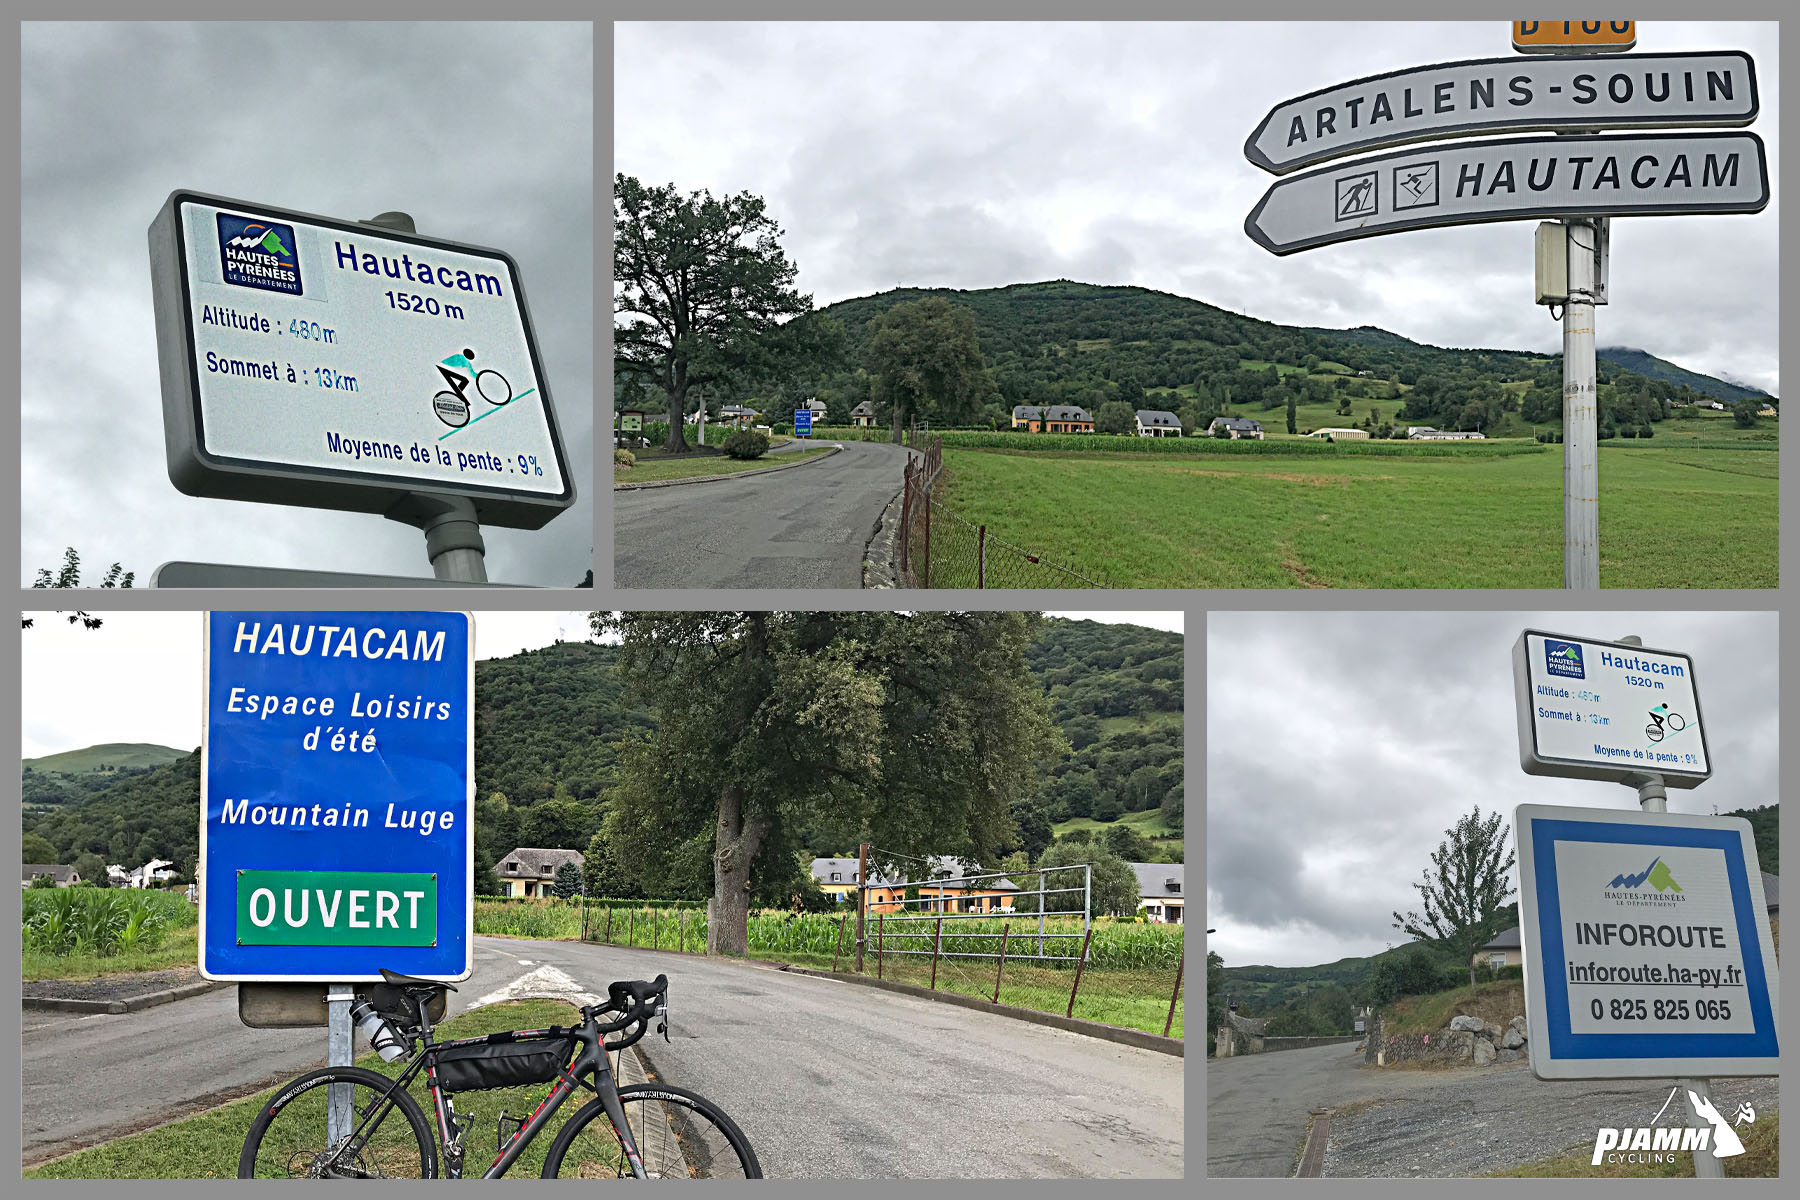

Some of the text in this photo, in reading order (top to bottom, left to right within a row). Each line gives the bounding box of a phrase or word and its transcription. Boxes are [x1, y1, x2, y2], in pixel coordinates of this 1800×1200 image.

[1286, 70, 1734, 147] ARTALENS-SOUIN
[1455, 152, 1740, 198] HAUTACAM
[227, 261, 296, 282] PYRÉNÉES
[229, 273, 297, 290] LE DÉPARTEMENT
[335, 241, 503, 297] Hautacam
[202, 304, 271, 333] Altitude
[385, 290, 465, 320] 1520 m
[206, 351, 280, 381] Sommet
[287, 363, 297, 383] à
[315, 367, 359, 392] 13km
[326, 431, 403, 460] Moyenne
[410, 442, 431, 463] de
[435, 445, 452, 466] la
[457, 451, 503, 472] pente
[517, 454, 543, 477] 9%
[233, 622, 447, 662] HAUTACAM
[1601, 651, 1684, 677] Hautacam
[1537, 684, 1569, 698] Altitude
[1625, 675, 1664, 689] 1520 m
[227, 687, 451, 721] Espace Loisirs
[1538, 707, 1573, 721] Sommet
[1594, 744, 1631, 757] Moyenne
[1633, 748, 1643, 759] de
[1646, 750, 1654, 760] la
[1656, 753, 1678, 763] pente
[221, 799, 454, 836] Mountain Luge
[249, 887, 425, 929] OUVERT
[1604, 891, 1686, 901] HAUTES-PYRÉNÉES
[1576, 922, 1726, 949] INFOROUTE
[1569, 961, 1742, 988] inforoute.ha-py.fr
[1591, 998, 1731, 1020] 0 825 825 065
